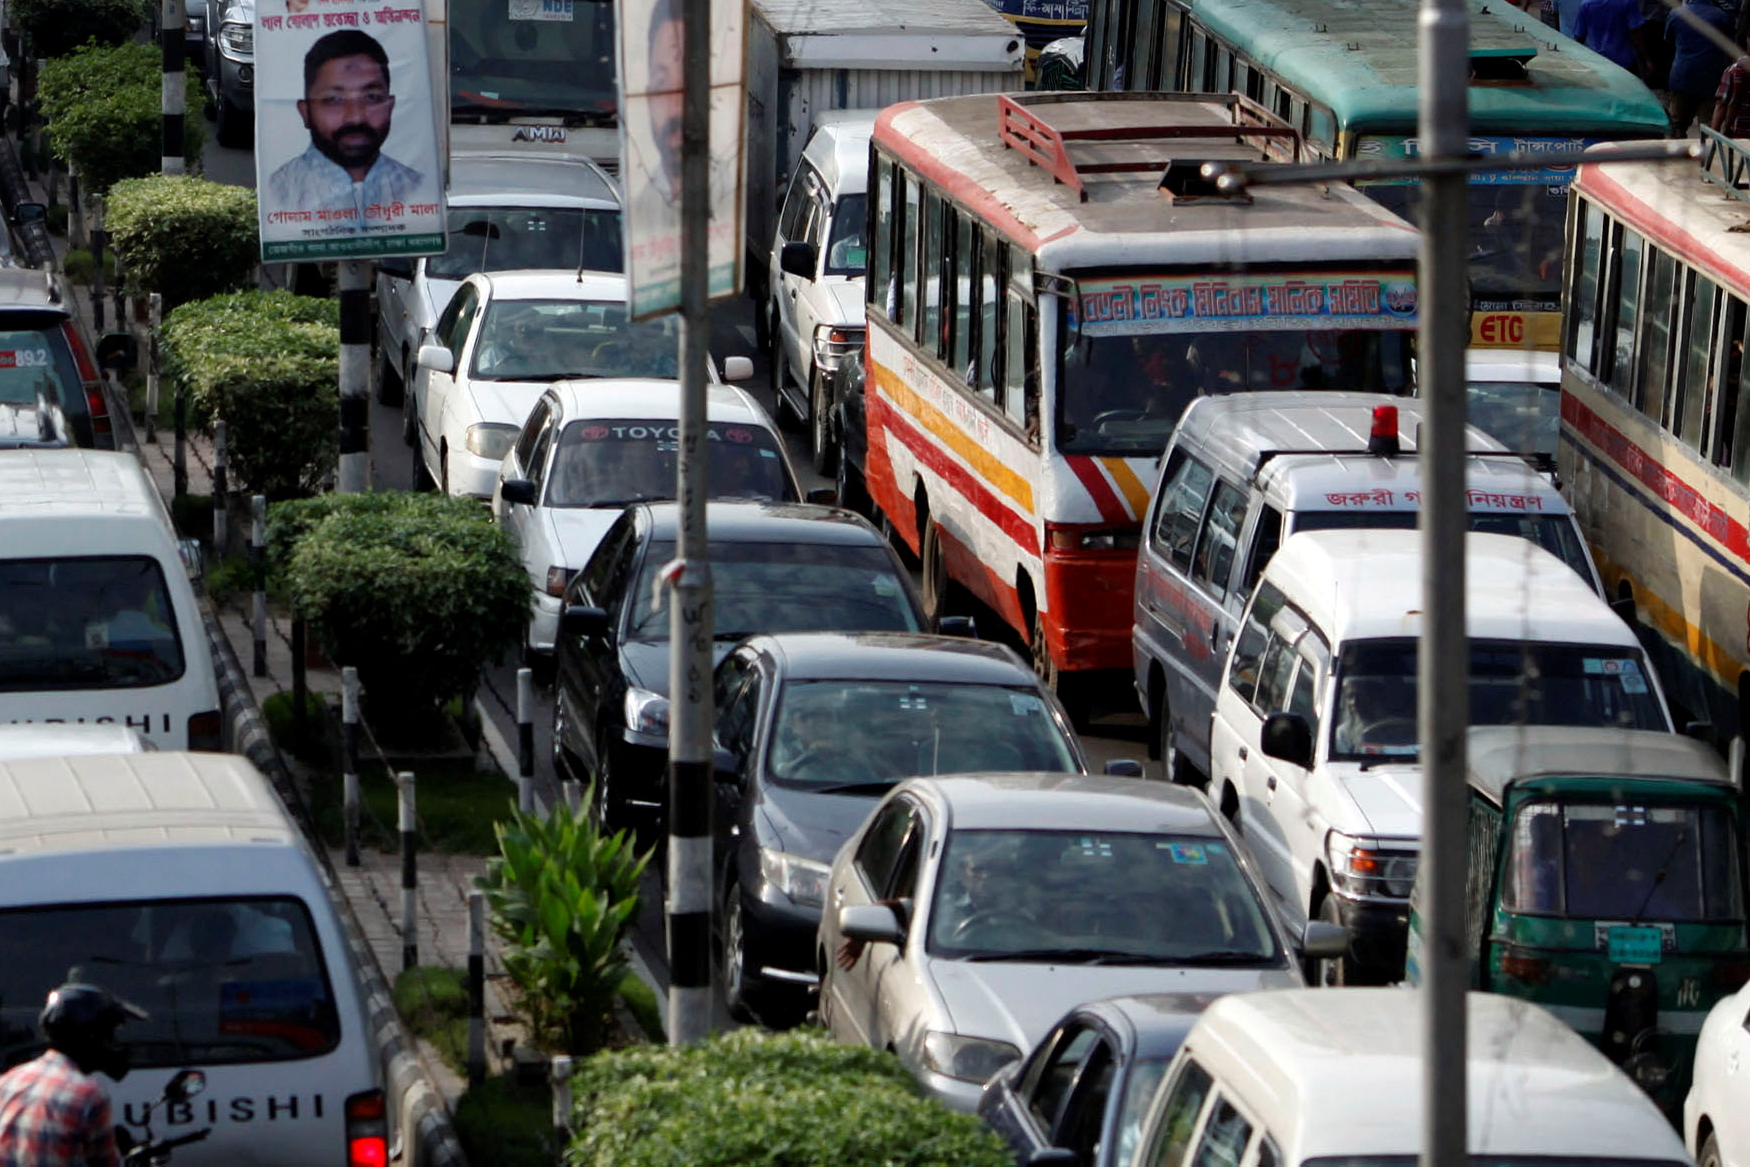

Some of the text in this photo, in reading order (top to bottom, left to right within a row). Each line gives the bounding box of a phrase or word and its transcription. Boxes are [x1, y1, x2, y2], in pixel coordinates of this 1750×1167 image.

[267, 209, 312, 225] গোলাম
[15, 348, 48, 367] 89.2
[612, 426, 722, 440] TOYOA
[1325, 488, 1394, 507] জরুরী
[123, 1093, 324, 1127] UBISHI
